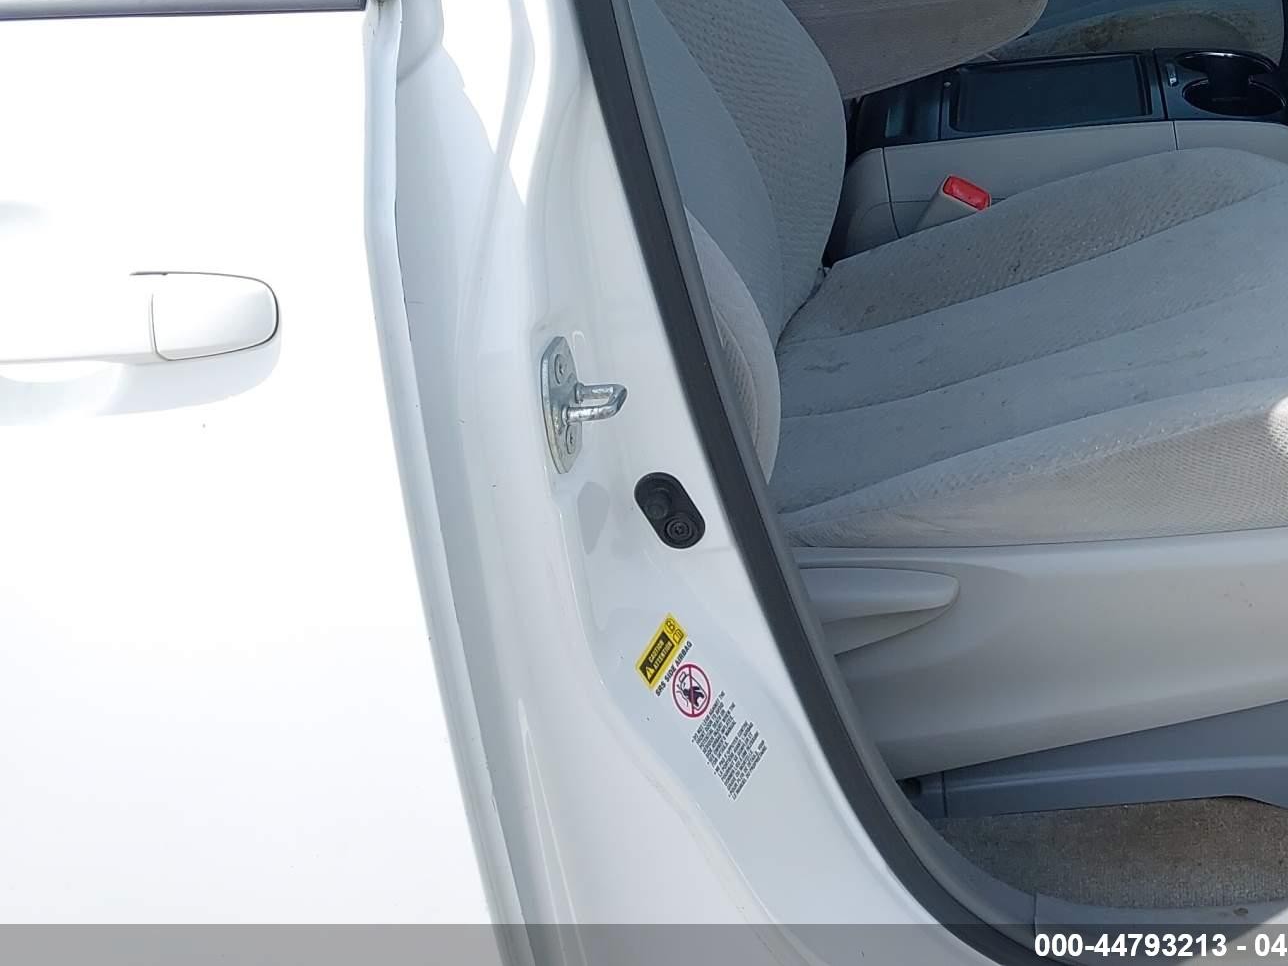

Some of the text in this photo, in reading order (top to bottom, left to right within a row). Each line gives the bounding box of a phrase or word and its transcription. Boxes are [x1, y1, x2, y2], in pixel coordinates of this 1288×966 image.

[648, 639, 665, 664] CAUTION
[655, 640, 693, 697] SRS SIDE AIRBAG
